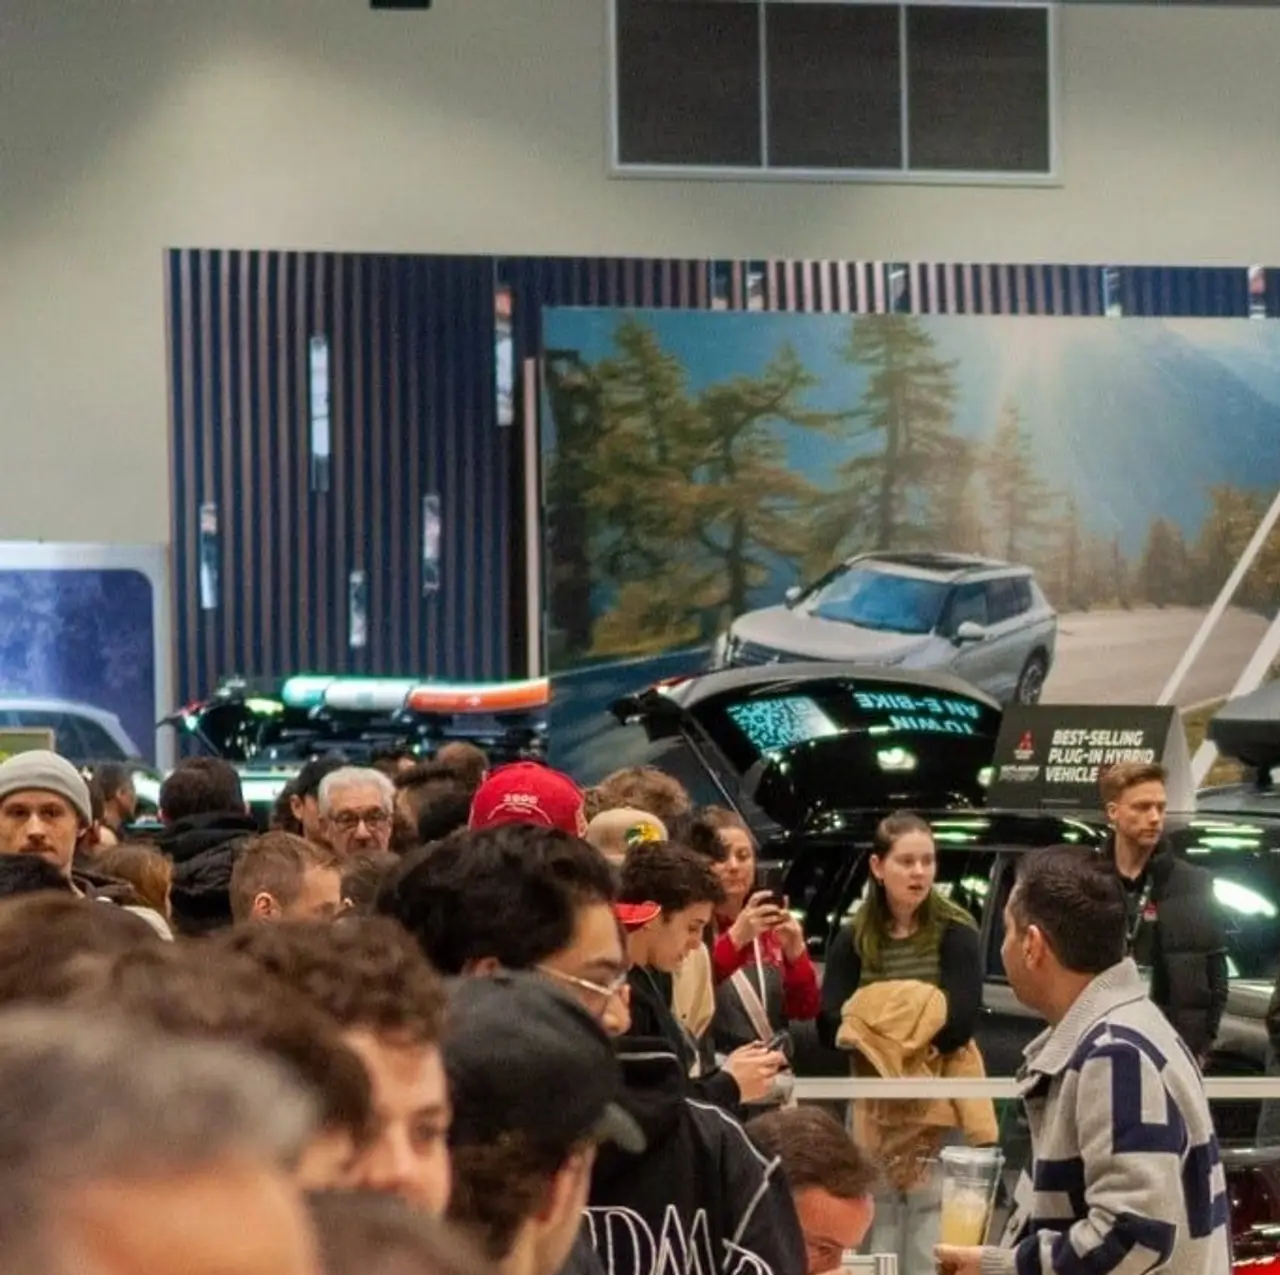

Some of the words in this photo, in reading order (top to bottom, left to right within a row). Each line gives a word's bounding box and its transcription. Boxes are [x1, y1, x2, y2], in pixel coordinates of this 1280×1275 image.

[853, 692, 944, 713] E-BIKE
[1051, 729, 1144, 747] BEST-SELLING
[1047, 748, 1103, 764] PLUG-IN
[1045, 766, 1100, 782] VEHICLE
